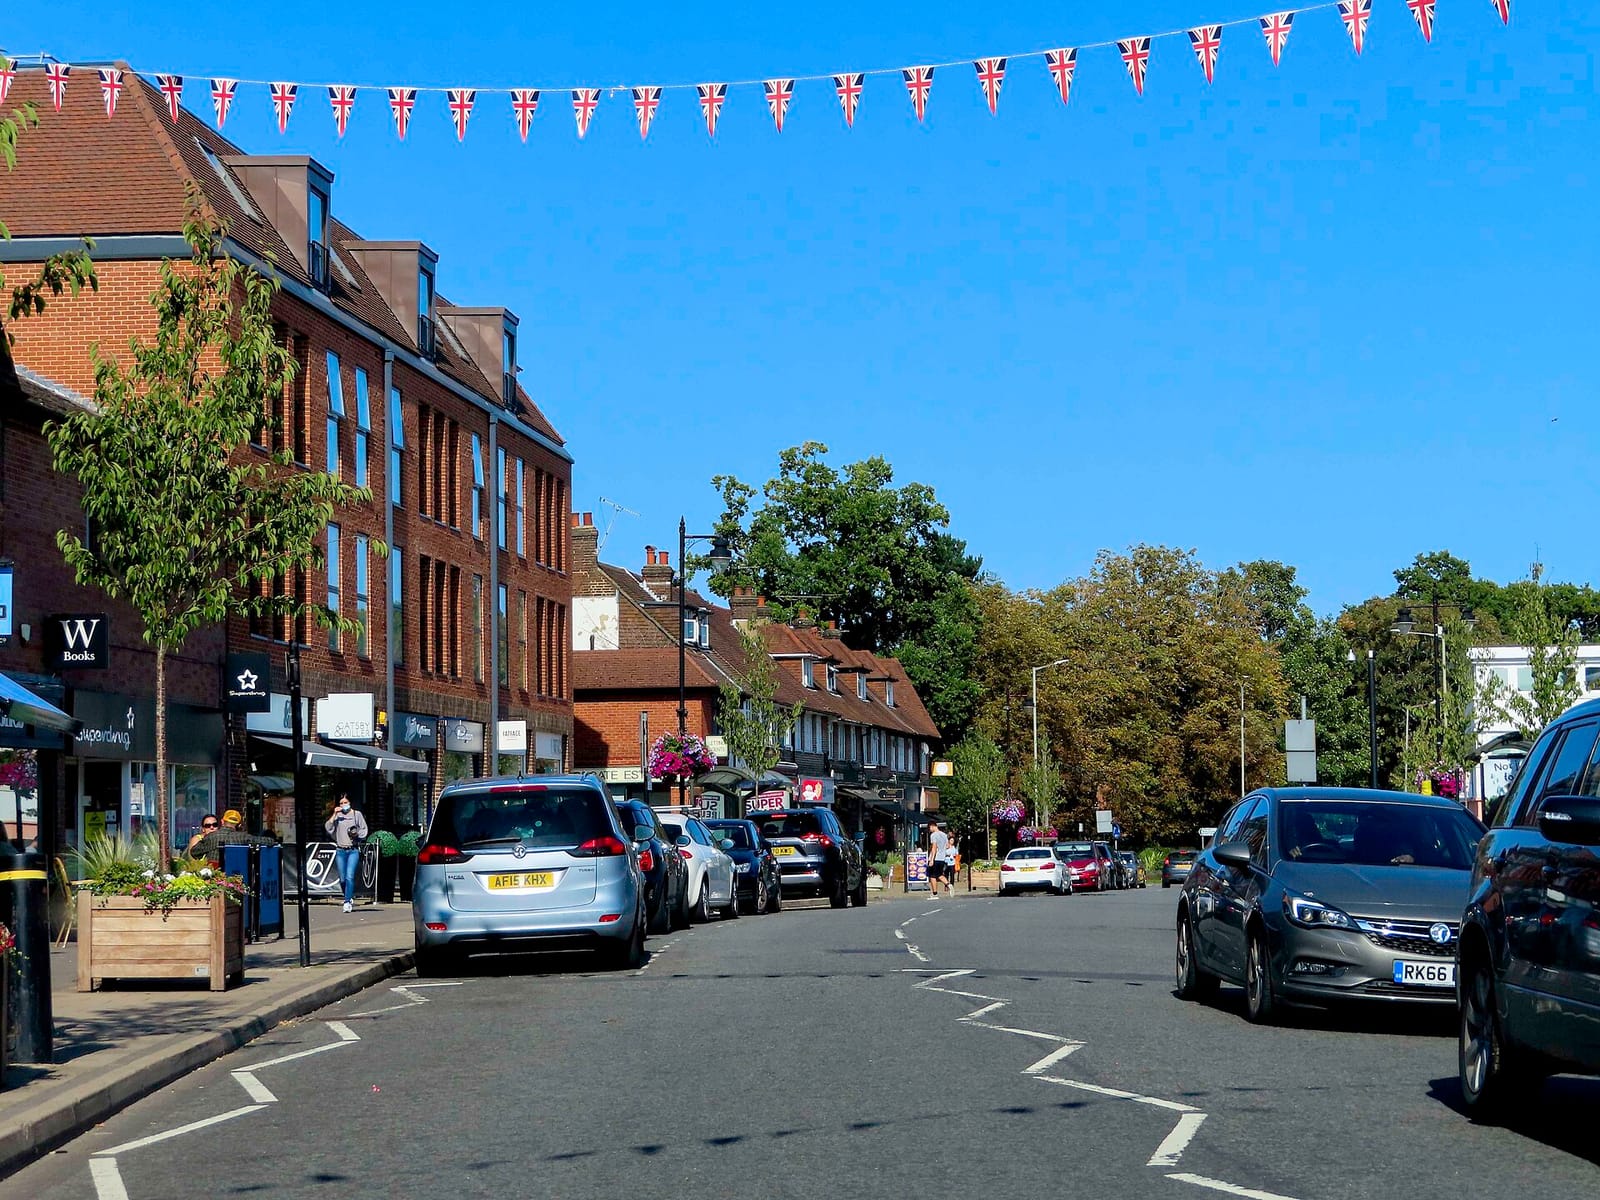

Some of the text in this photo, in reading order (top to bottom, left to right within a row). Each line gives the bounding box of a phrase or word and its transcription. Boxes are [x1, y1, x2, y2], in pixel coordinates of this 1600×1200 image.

[59, 618, 101, 649] W
[63, 651, 96, 661] Books
[337, 721, 370, 730] GATSBY
[494, 874, 547, 887] AF15 KHX
[1404, 964, 1447, 981] RK66
